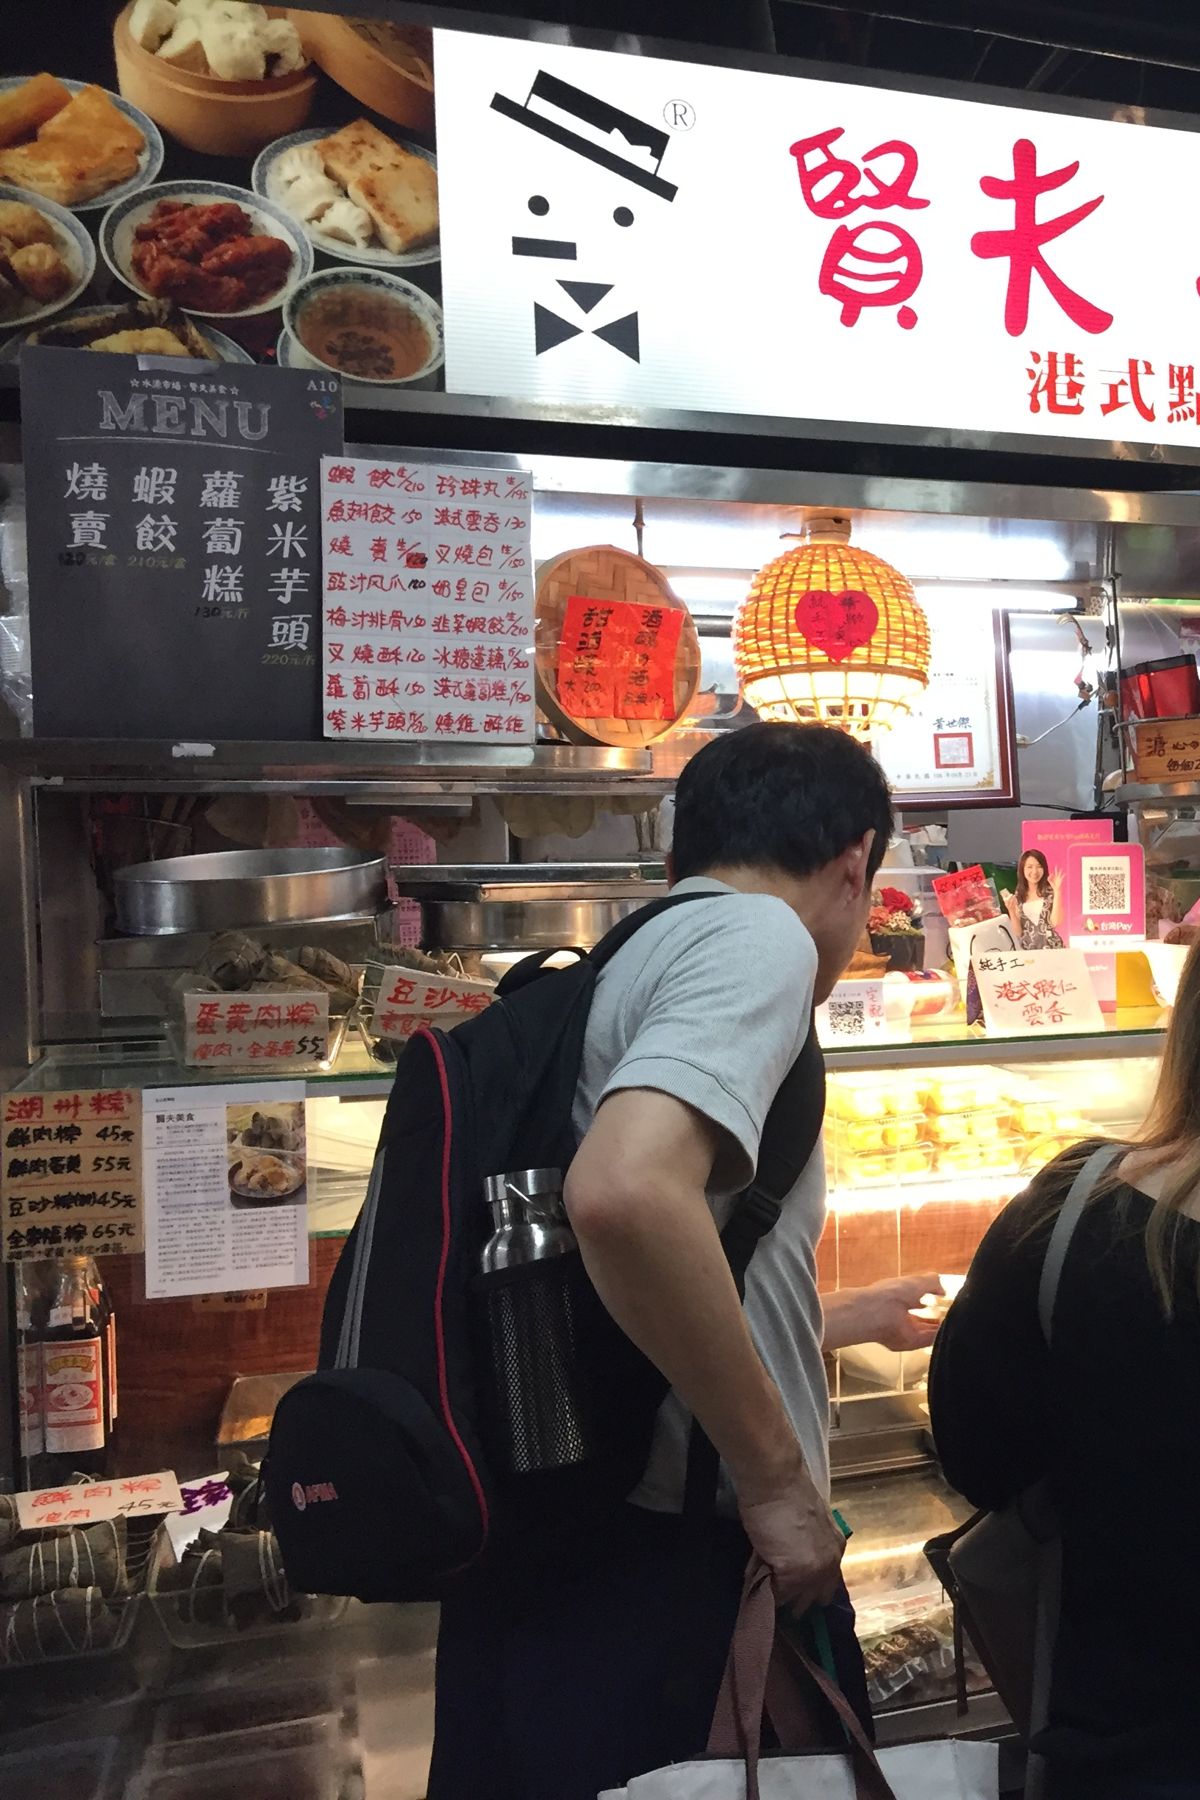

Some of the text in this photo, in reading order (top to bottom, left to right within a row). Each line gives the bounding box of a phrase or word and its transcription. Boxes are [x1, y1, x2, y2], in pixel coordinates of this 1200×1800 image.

[307, 380, 338, 392] A10
[98, 390, 271, 441] MENU
[436, 475, 500, 498] 珍珠丸
[64, 462, 111, 549] 燒賣
[132, 467, 178, 552] 蝦餃
[199, 470, 245, 603] 蘿蔔糕
[265, 475, 313, 651] 紫米芋頭
[979, 957, 1024, 971] 純手工
[387, 977, 493, 1013] 豆沙粽
[197, 1002, 320, 1034] 蛋黃肉粽
[96, 1125, 135, 1142] 45元
[92, 1156, 132, 1172] 55元
[92, 1223, 136, 1239] 65元
